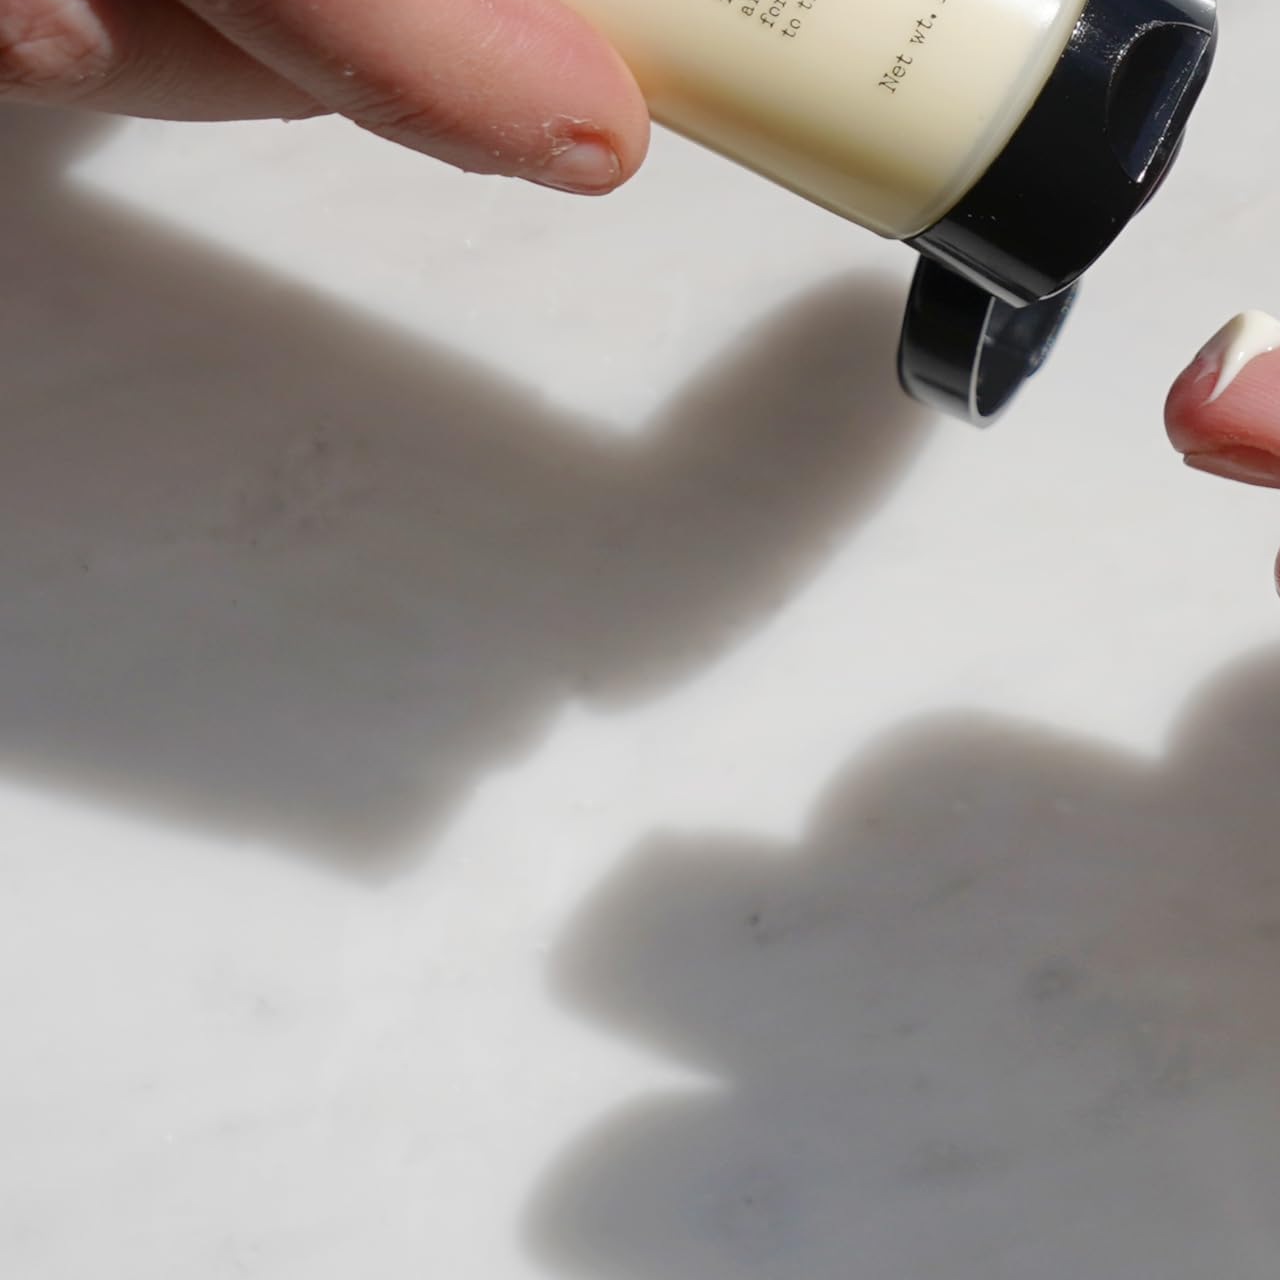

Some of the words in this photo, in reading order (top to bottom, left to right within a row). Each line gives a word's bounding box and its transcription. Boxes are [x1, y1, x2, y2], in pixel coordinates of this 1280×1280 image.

[781, 18, 802, 39] to
[877, 53, 914, 95] Net
[908, 13, 938, 45] wt.
